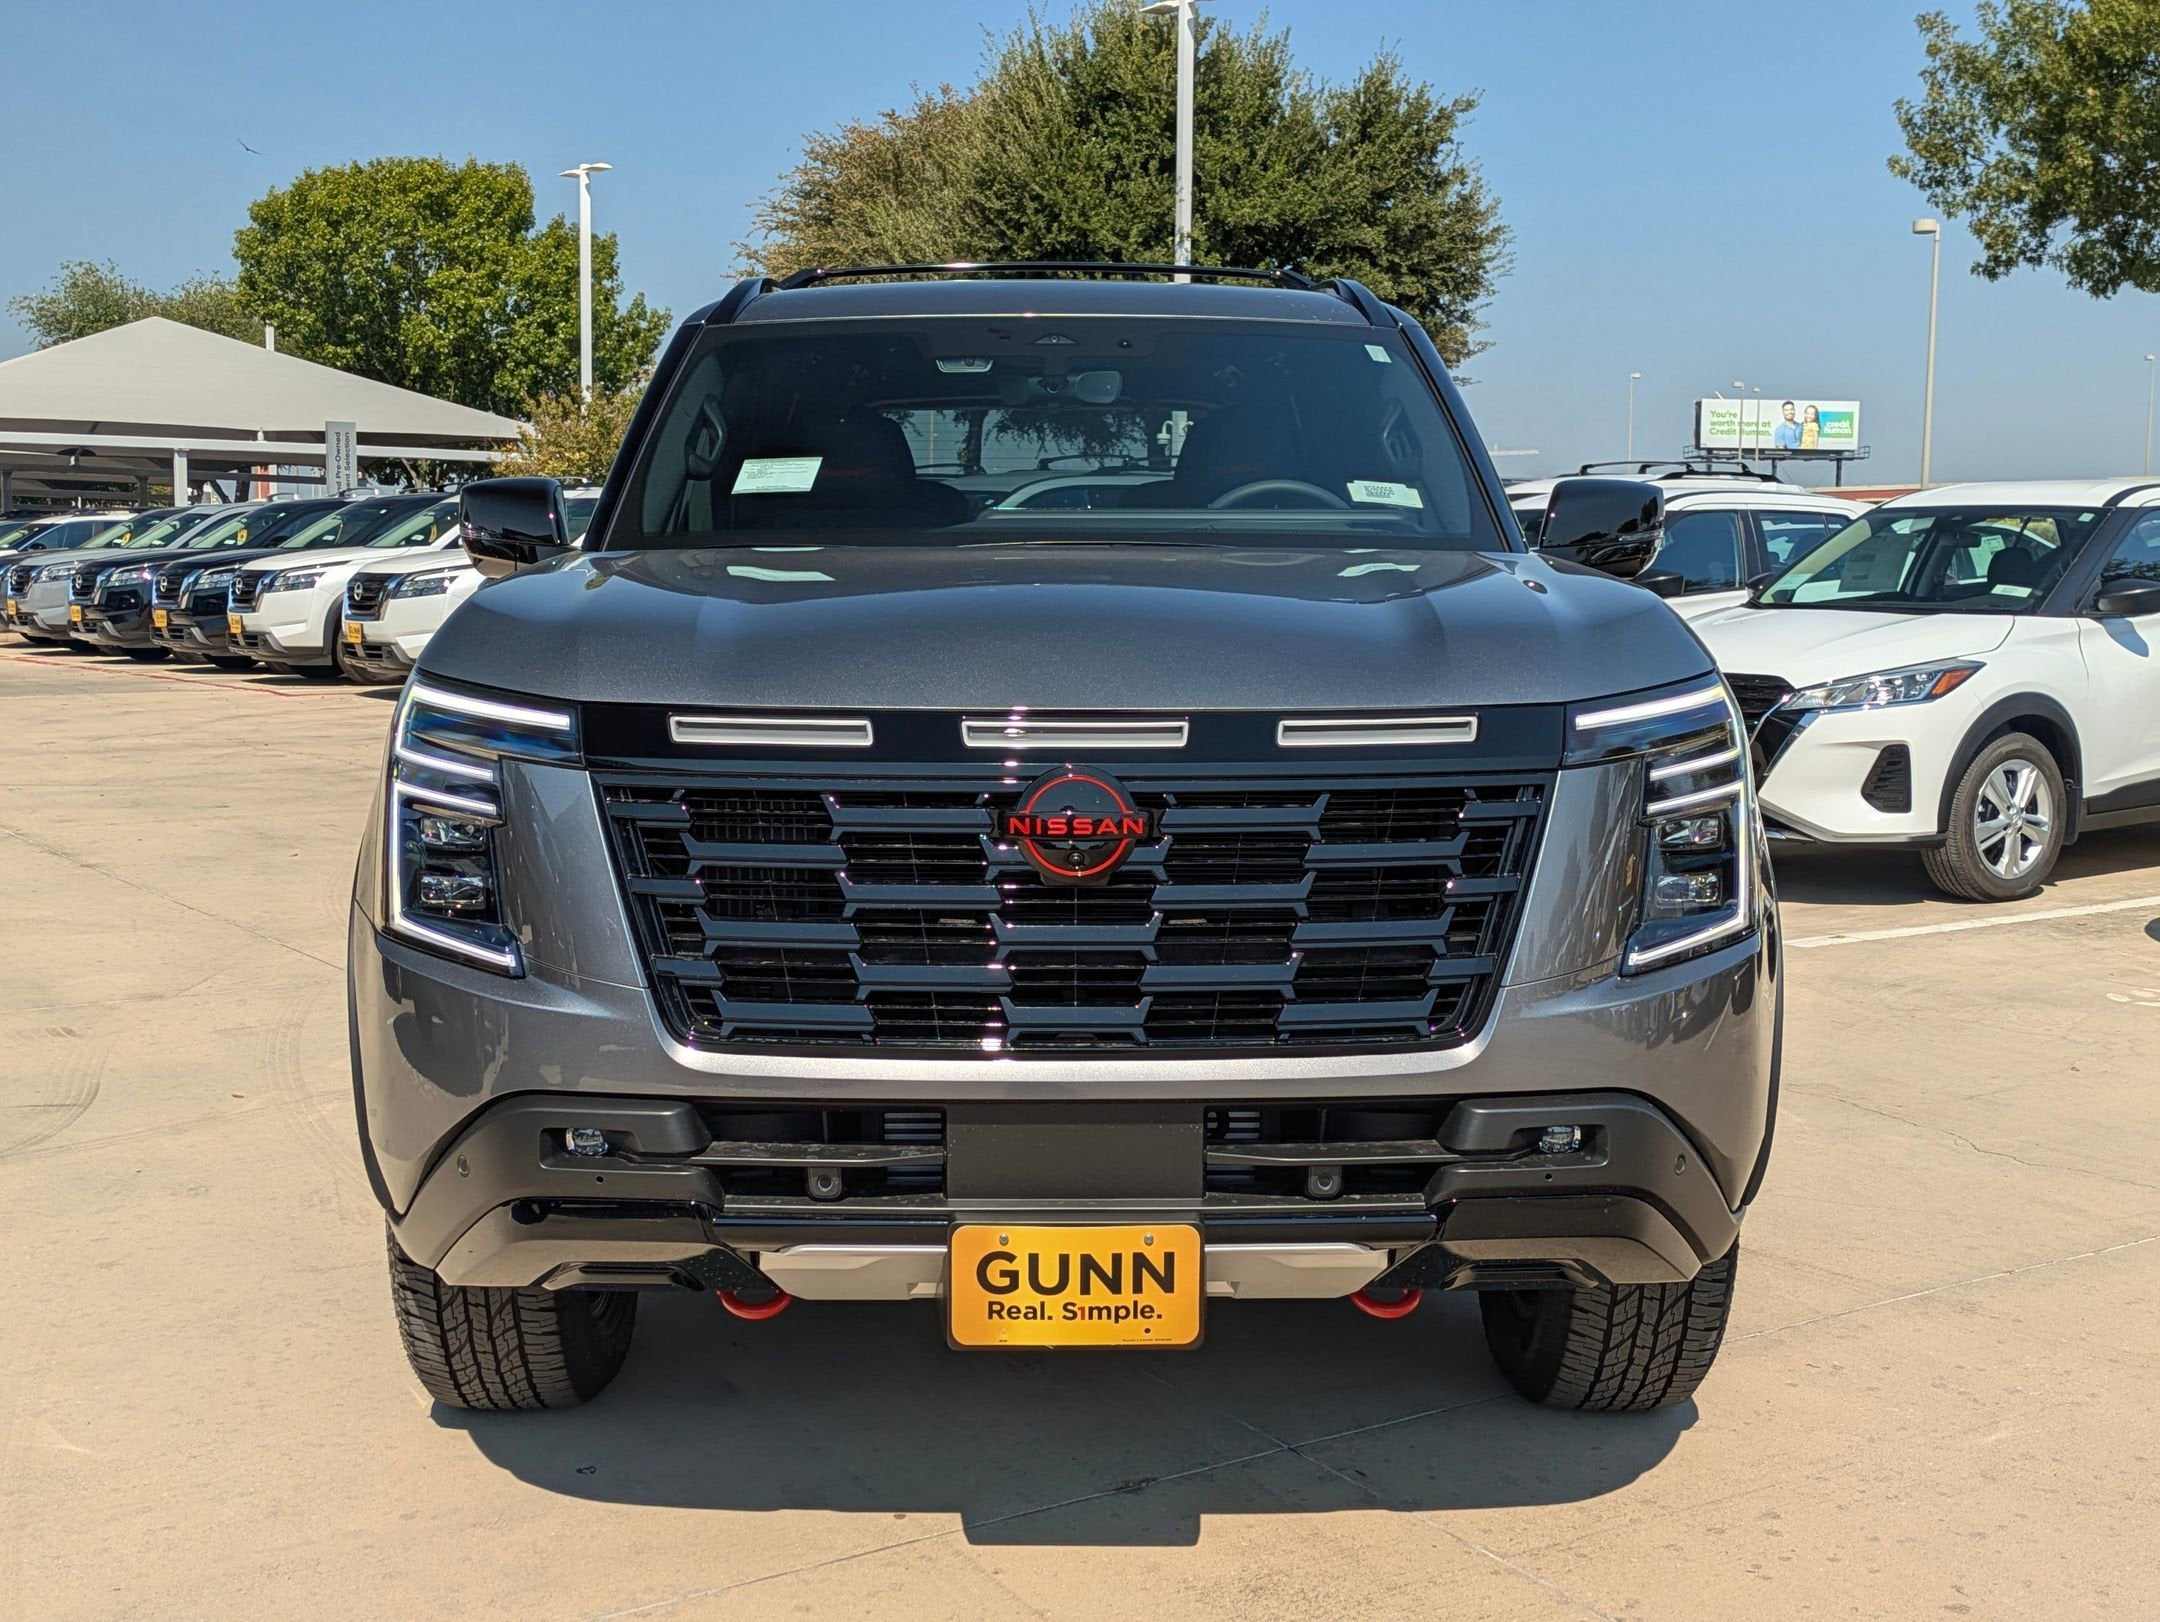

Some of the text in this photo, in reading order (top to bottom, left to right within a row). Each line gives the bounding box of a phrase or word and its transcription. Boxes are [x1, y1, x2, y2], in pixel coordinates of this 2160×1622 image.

[1710, 410, 1738, 418] You're
[1761, 420, 1772, 428] at
[1709, 427, 1737, 436] Credit
[1009, 817, 1144, 835] NISSAN
[976, 1250, 1176, 1296] GUNN
[987, 1300, 1053, 1321] Real.
